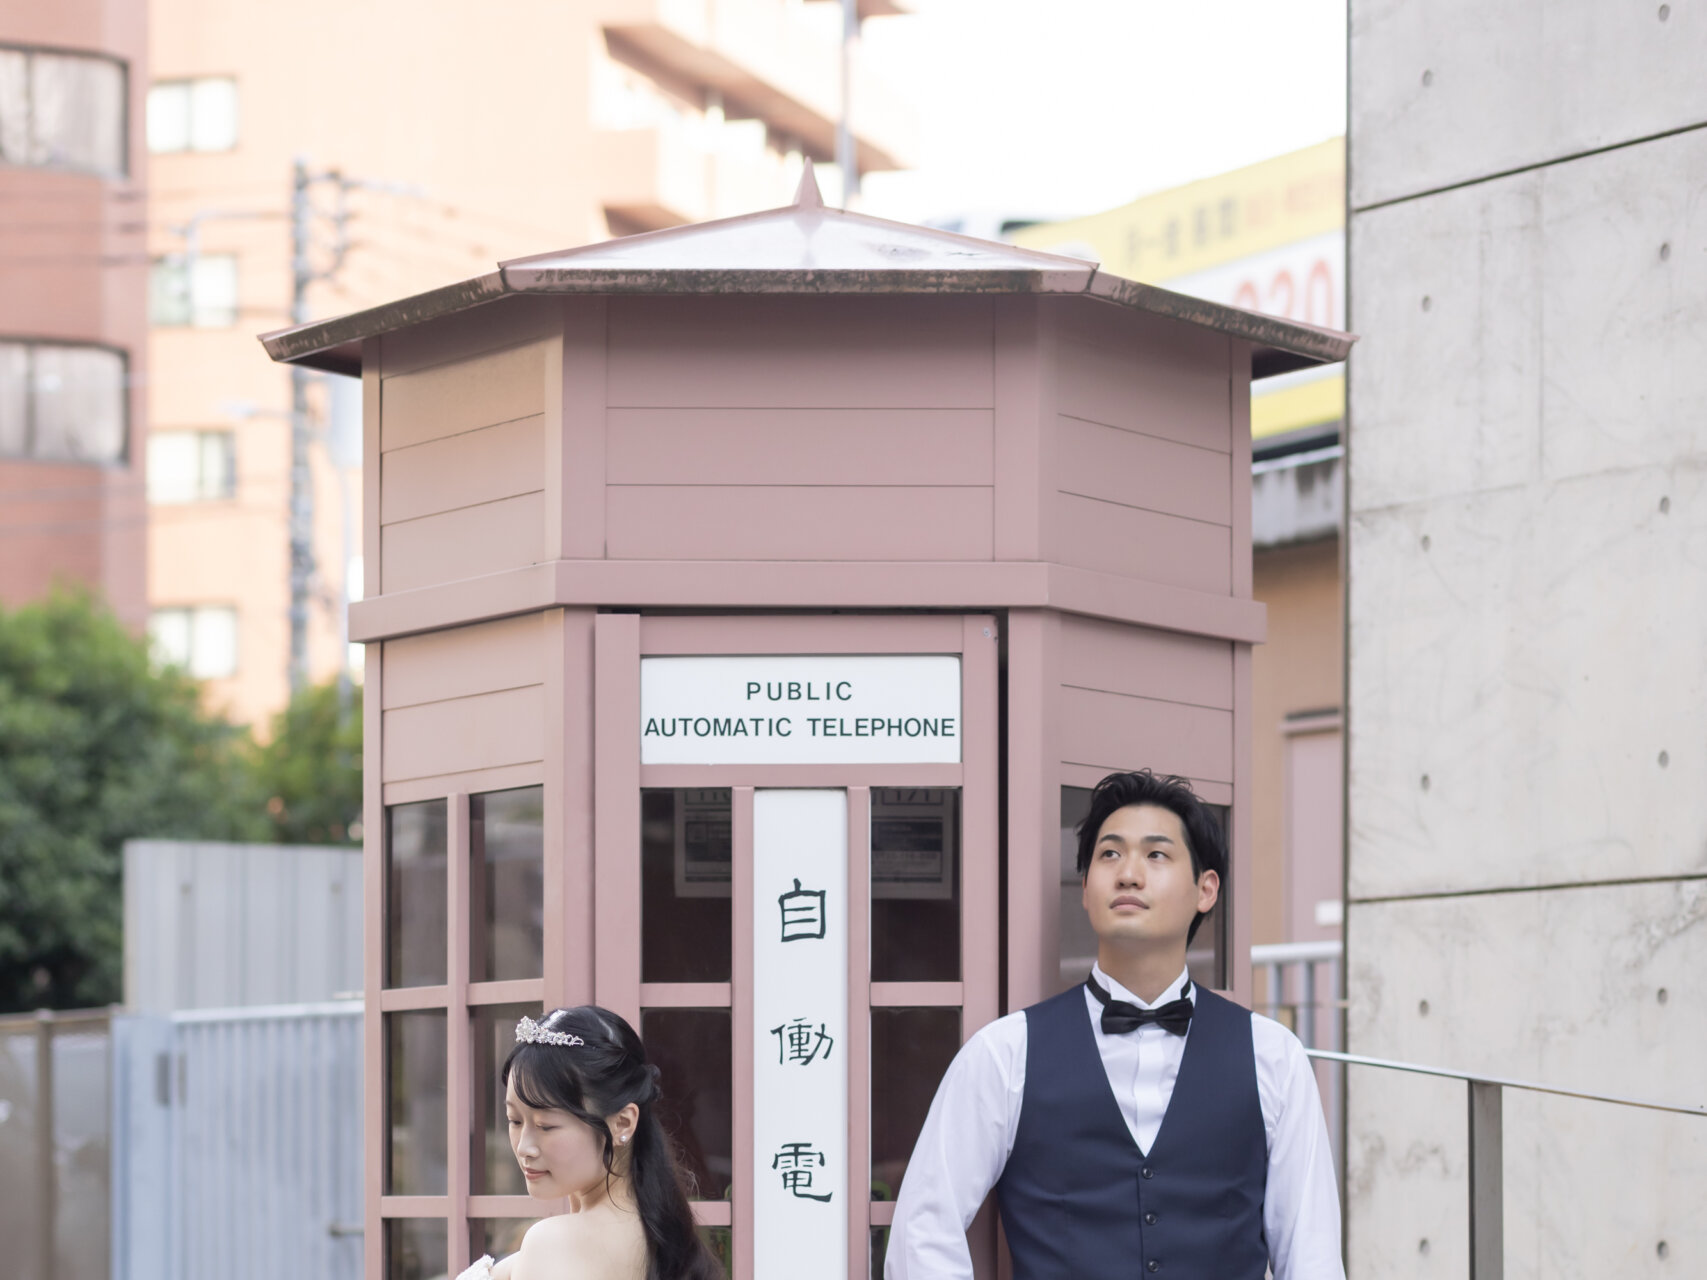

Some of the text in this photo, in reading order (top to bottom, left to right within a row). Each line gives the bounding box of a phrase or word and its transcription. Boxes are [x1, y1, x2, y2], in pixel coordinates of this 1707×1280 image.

[746, 681, 852, 701] PUBLIC
[644, 717, 955, 737] AUTOMATIC TELEPHONE
